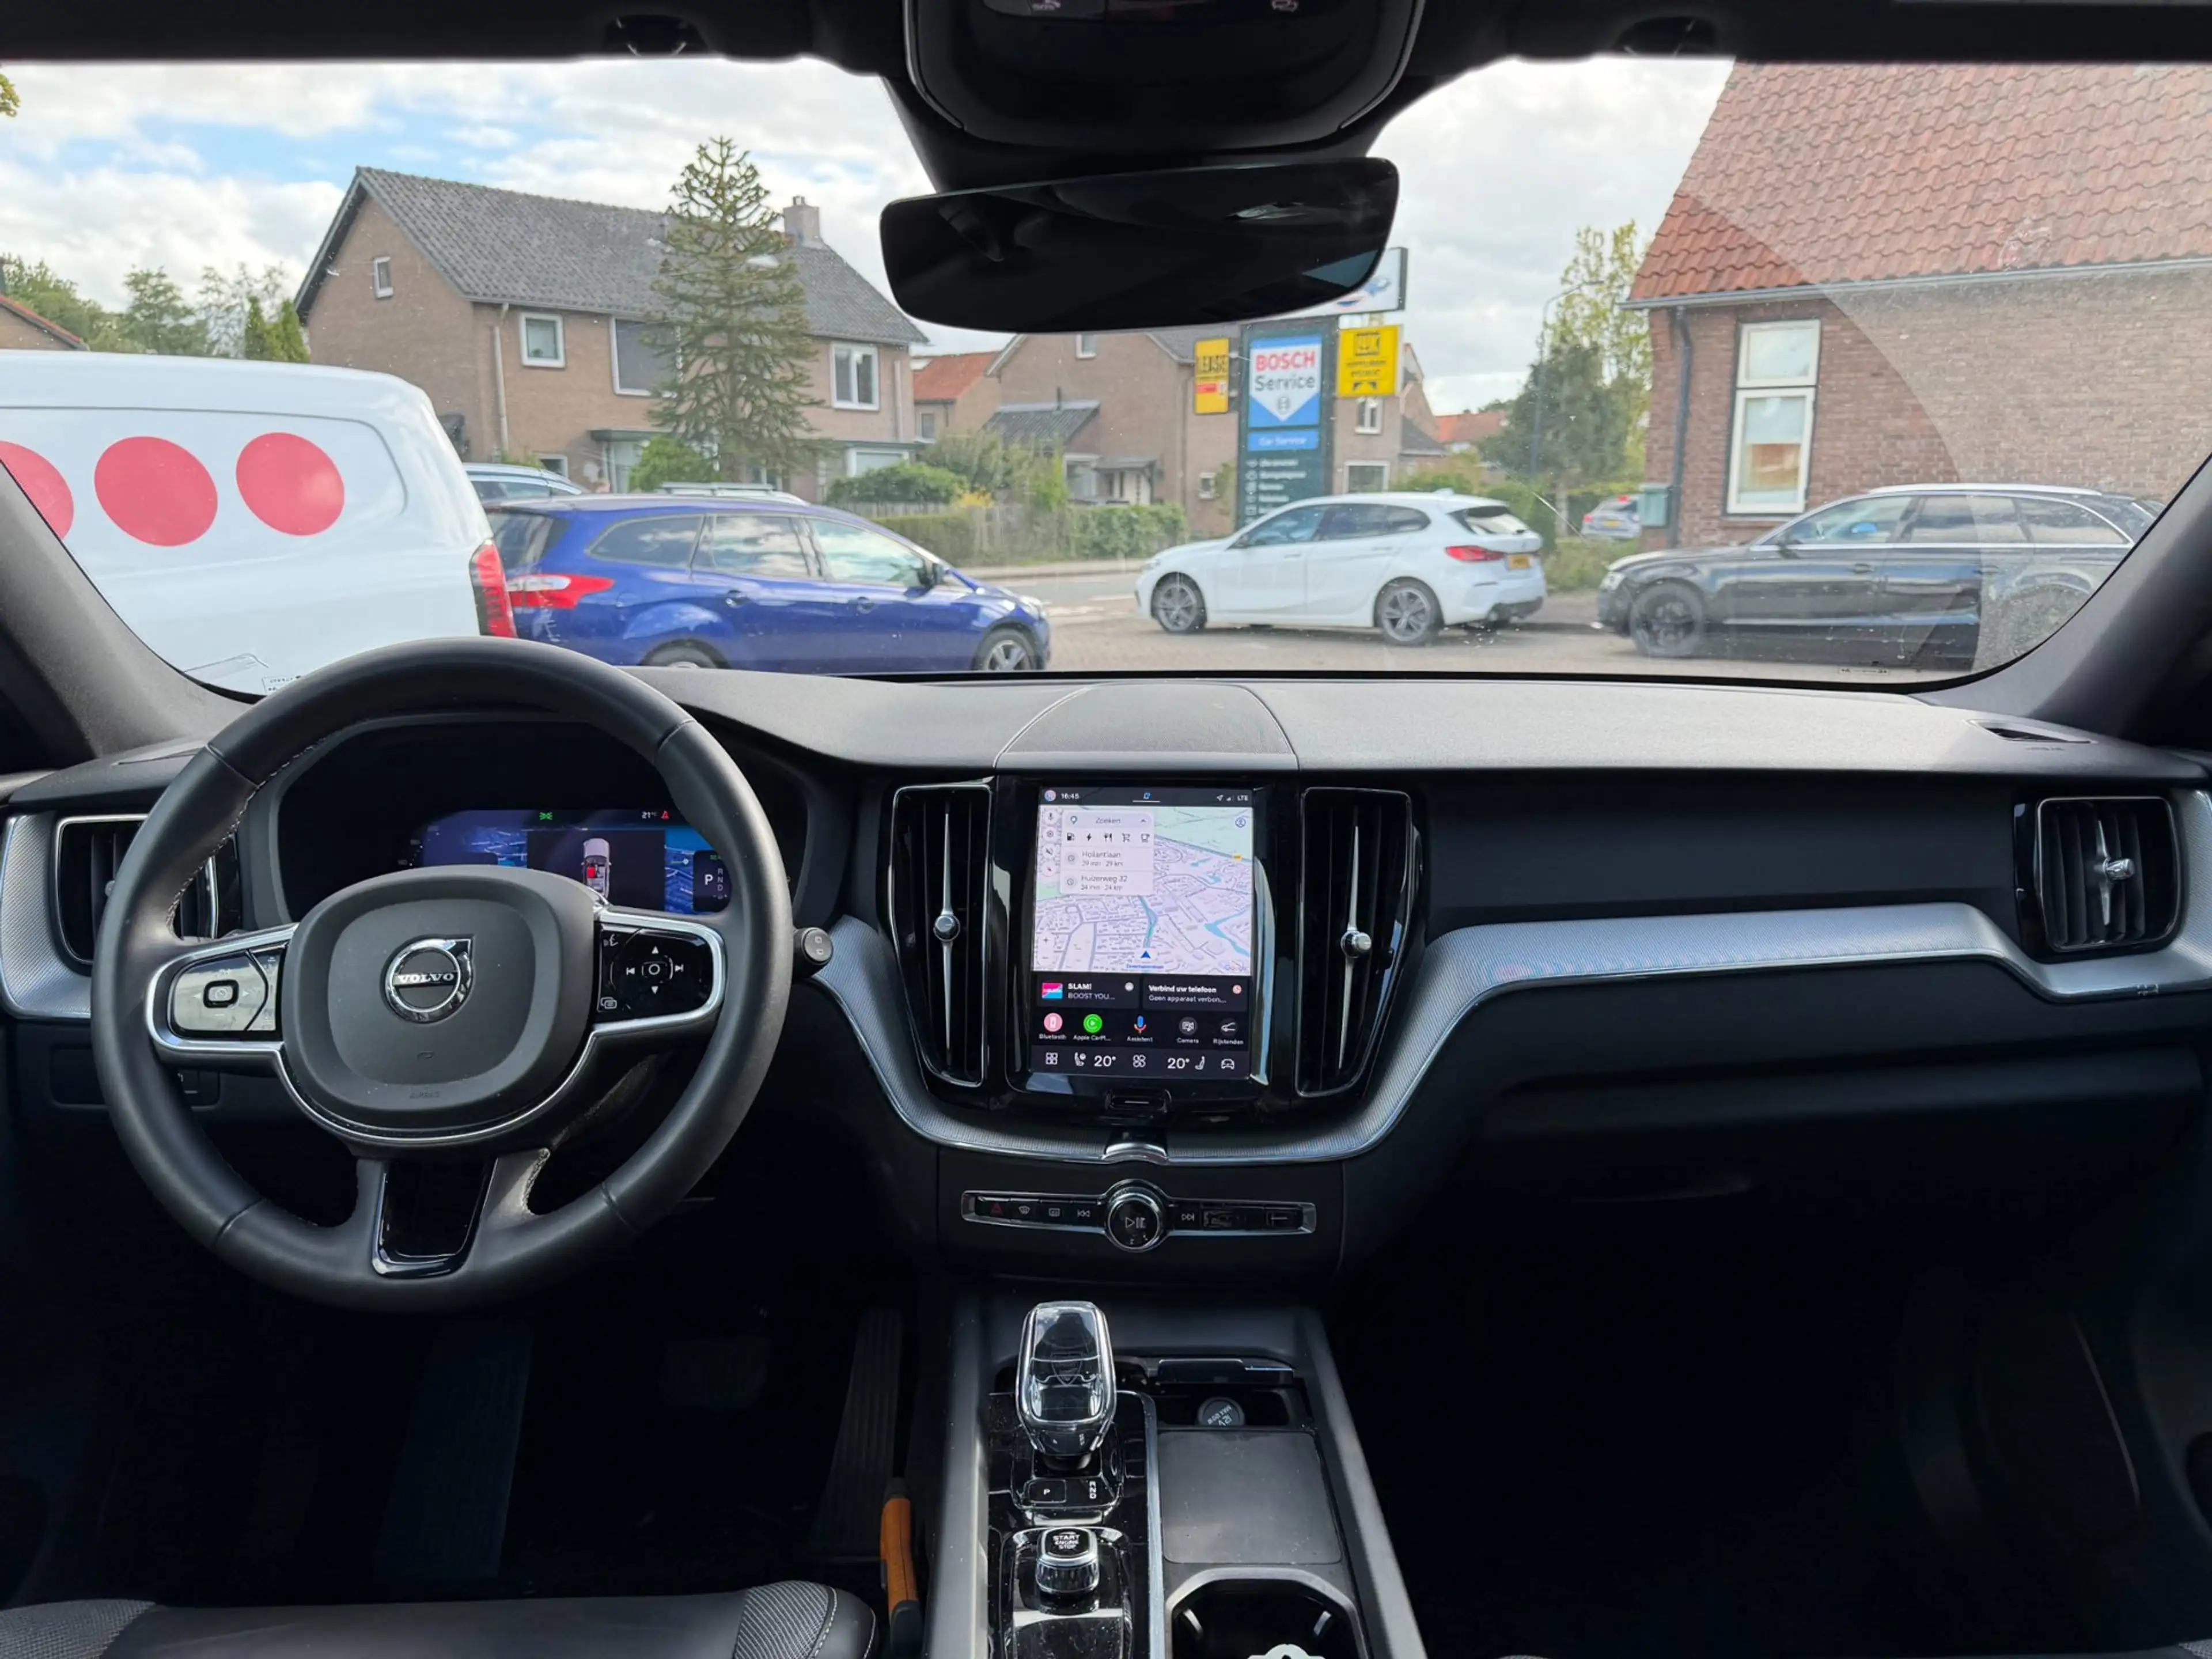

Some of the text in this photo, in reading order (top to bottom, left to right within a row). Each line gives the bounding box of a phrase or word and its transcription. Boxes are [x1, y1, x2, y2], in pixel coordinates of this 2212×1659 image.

[1255, 350, 1316, 372] BOSCH
[1255, 373, 1315, 392] Service
[704, 874, 714, 885] P
[397, 973, 454, 983] VOLVO
[1188, 985, 1217, 993] telefoon
[1167, 995, 1196, 1003] apparaat
[1094, 1055, 1116, 1067] 20°
[1167, 1058, 1190, 1069] 20°
